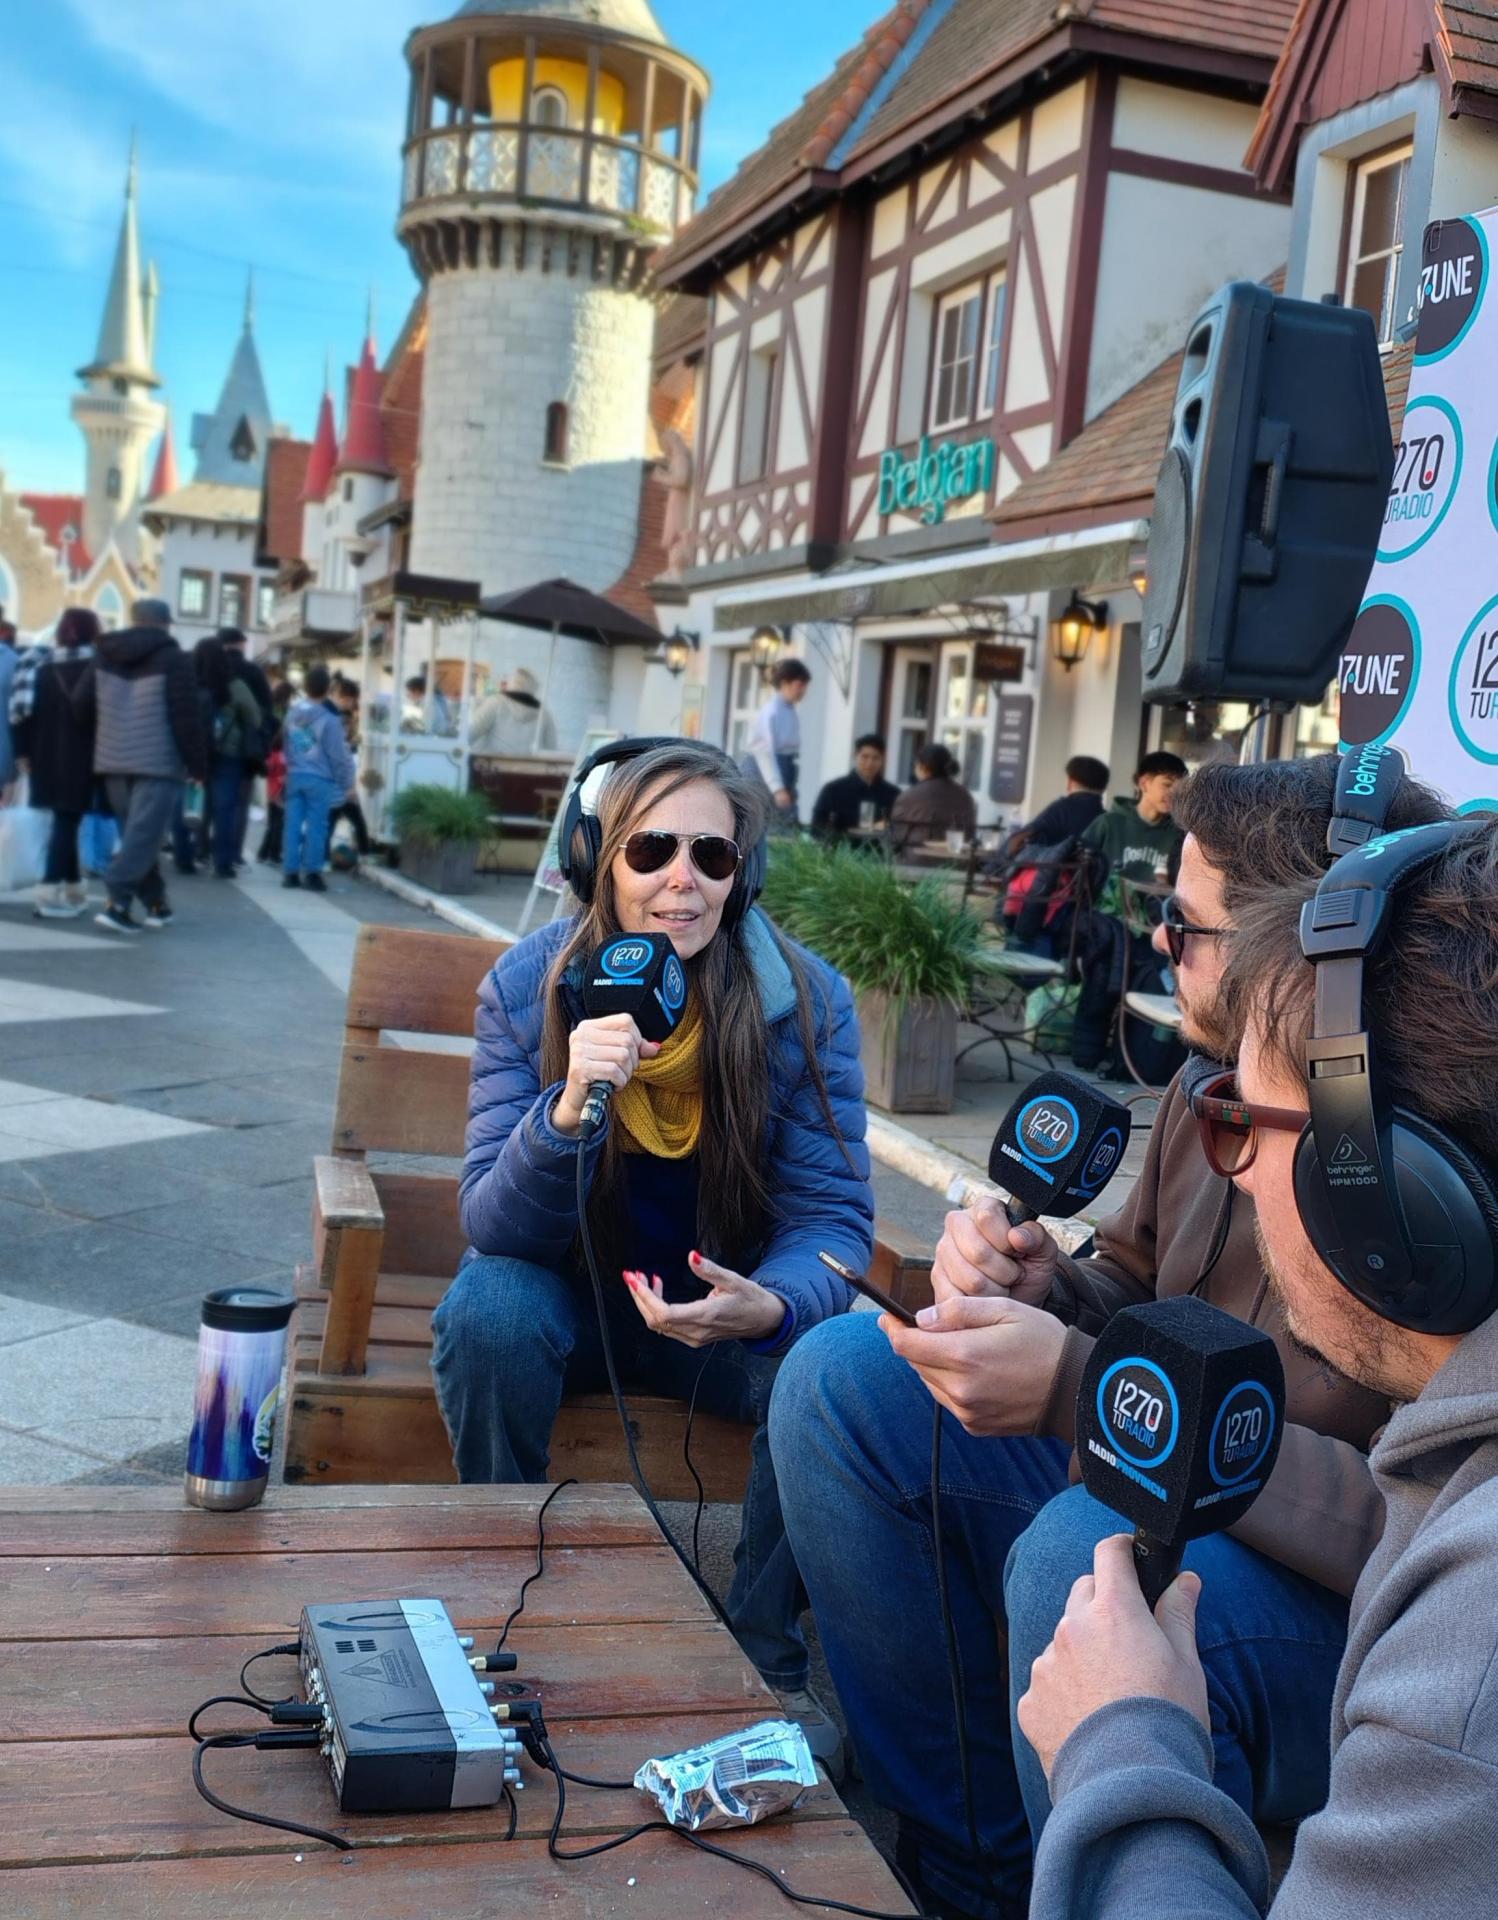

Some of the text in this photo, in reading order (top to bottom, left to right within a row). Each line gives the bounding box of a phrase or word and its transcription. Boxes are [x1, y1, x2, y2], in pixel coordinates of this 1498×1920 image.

[879, 435, 995, 525] Belgian
[1389, 433, 1445, 496] 270
[1383, 492, 1434, 524] URADIO
[1472, 630, 1498, 689] 12
[612, 947, 644, 961] 1270
[1030, 1107, 1068, 1142] 1270
[1326, 1165, 1376, 1176] behringer
[1329, 1176, 1378, 1186] HPM1000
[1114, 1378, 1164, 1433] 1270
[1113, 1408, 1156, 1450] TURADIO
[1224, 1406, 1262, 1449] 1270
